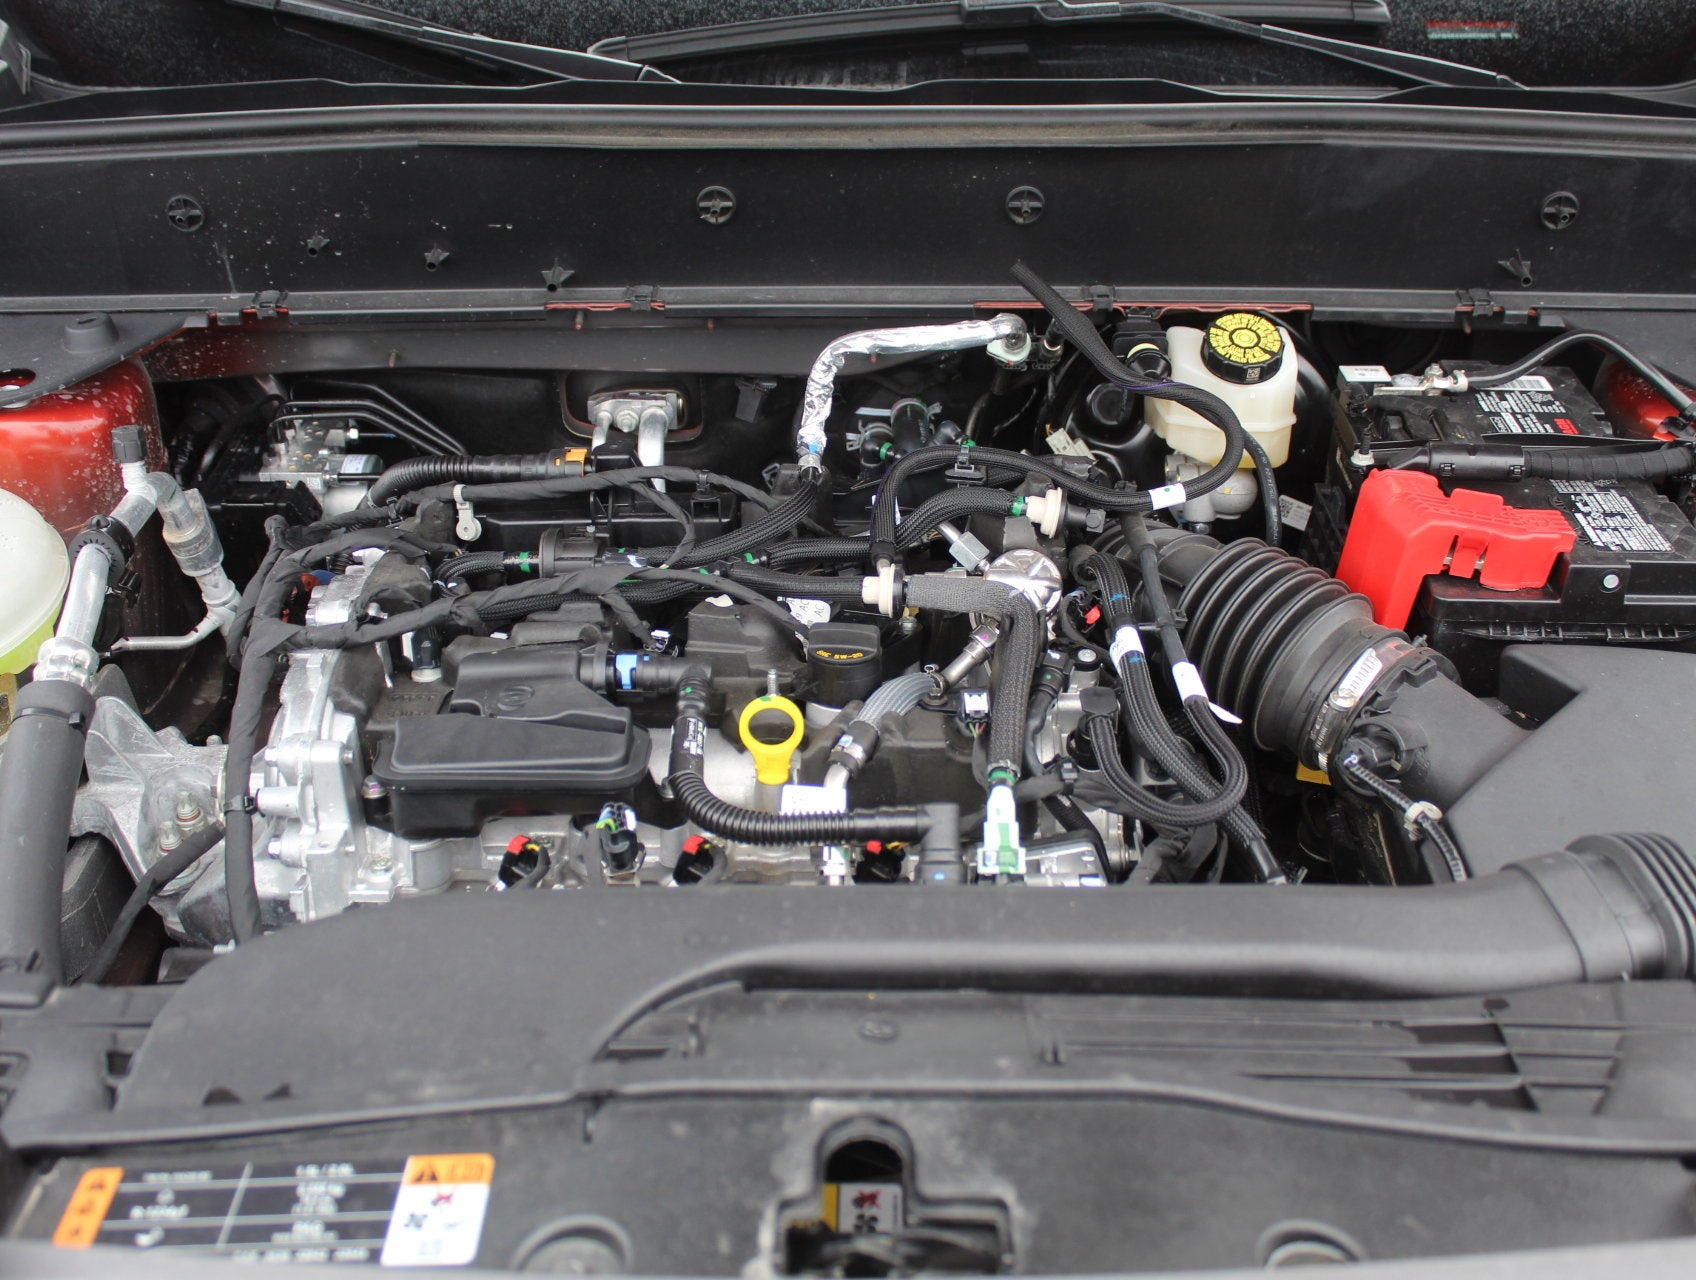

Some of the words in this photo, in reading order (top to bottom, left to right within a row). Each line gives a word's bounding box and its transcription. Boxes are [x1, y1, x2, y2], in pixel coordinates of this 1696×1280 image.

[814, 604, 825, 617] AC
[816, 650, 832, 658] SAE
[833, 652, 864, 660] 5W-20
